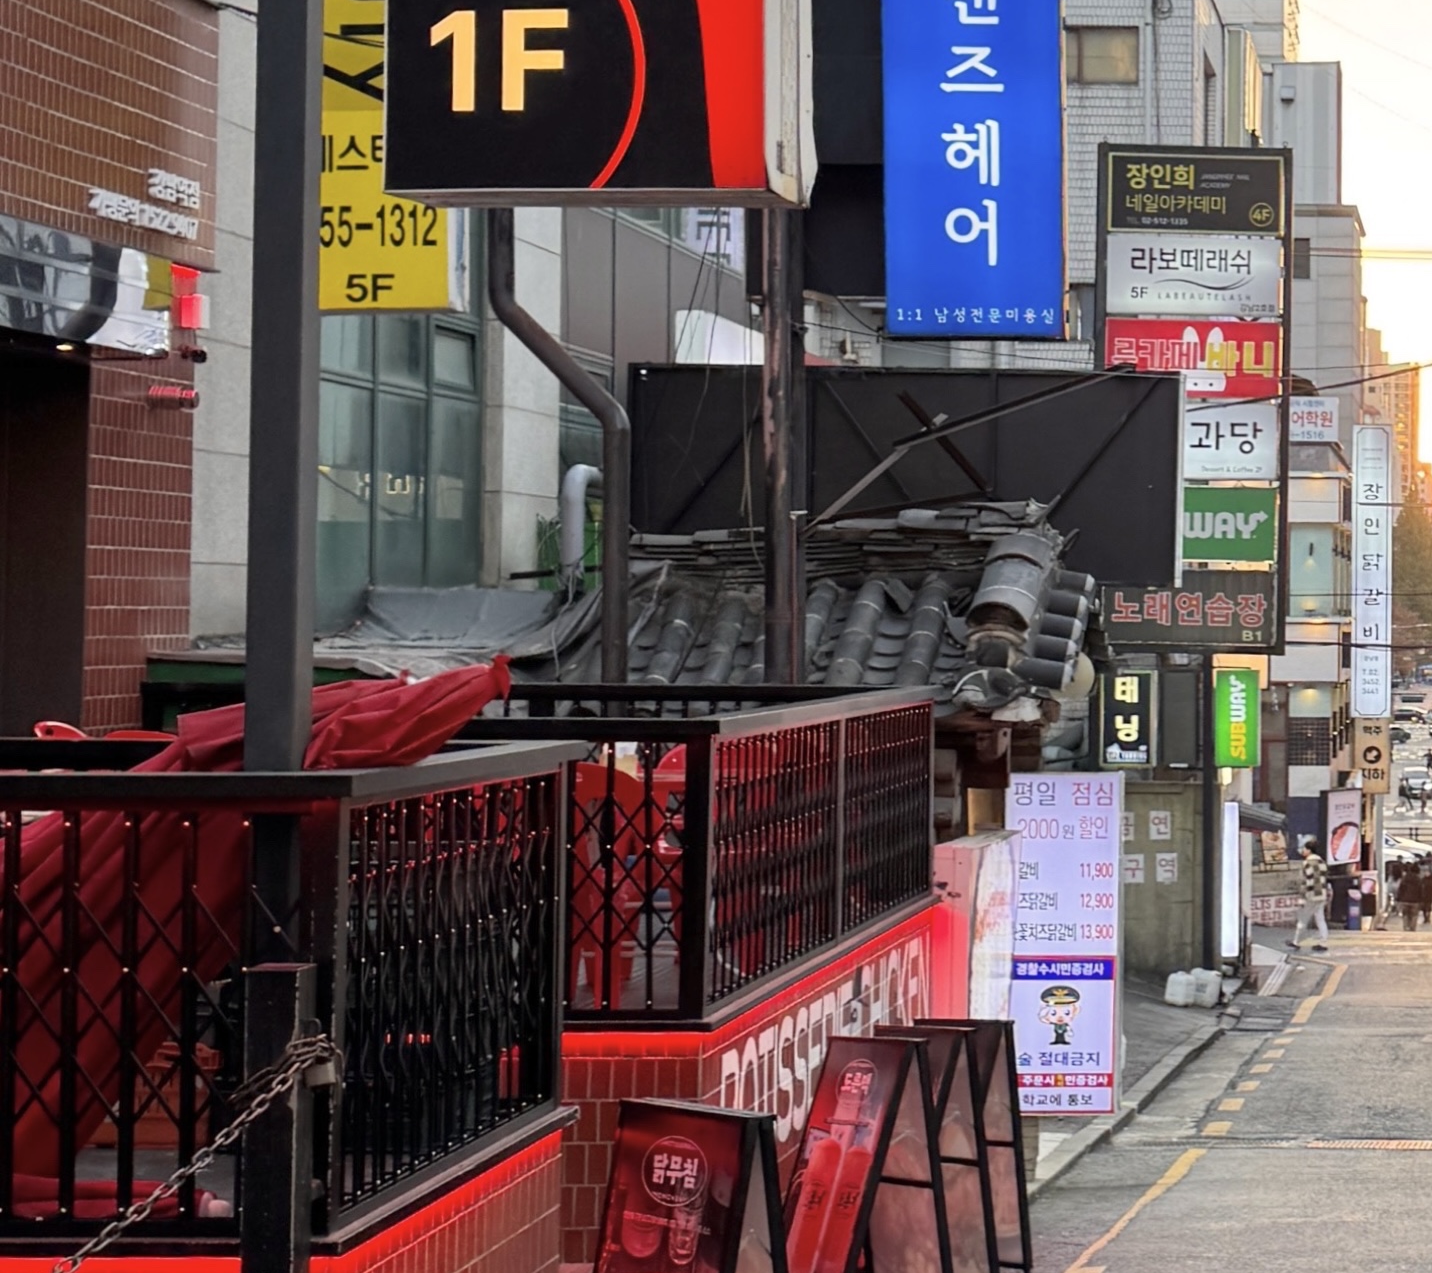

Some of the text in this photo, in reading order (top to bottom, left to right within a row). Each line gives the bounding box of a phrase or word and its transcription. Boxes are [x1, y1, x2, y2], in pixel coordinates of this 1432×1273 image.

[429, 7, 570, 114] 1F
[1125, 162, 1195, 191] 장인희
[1125, 193, 1272, 222] 네일아카데미 4F
[1130, 246, 1252, 276] 라보떼래쉬
[345, 273, 396, 303] 5F
[1130, 285, 1150, 300] 5F
[896, 308, 924, 322] 1:1
[1291, 409, 1334, 429] 어학원
[1188, 420, 1264, 456] 과당
[1110, 591, 1268, 628] 노래연습장
[1241, 629, 1264, 643] B1
[1114, 675, 1141, 743] 태닝
[1229, 674, 1248, 762] SUBWAY
[1013, 781, 1115, 807] 평일 점심
[1078, 815, 1110, 841] 할인
[1079, 861, 1114, 881] 11,900
[1079, 892, 1114, 911] 12,900
[1079, 923, 1114, 940] 13,900
[1037, 1050, 1102, 1068] 절대금지
[1022, 1093, 1094, 1107] 학교에 통보
[651, 1152, 699, 1190] 닭무침
